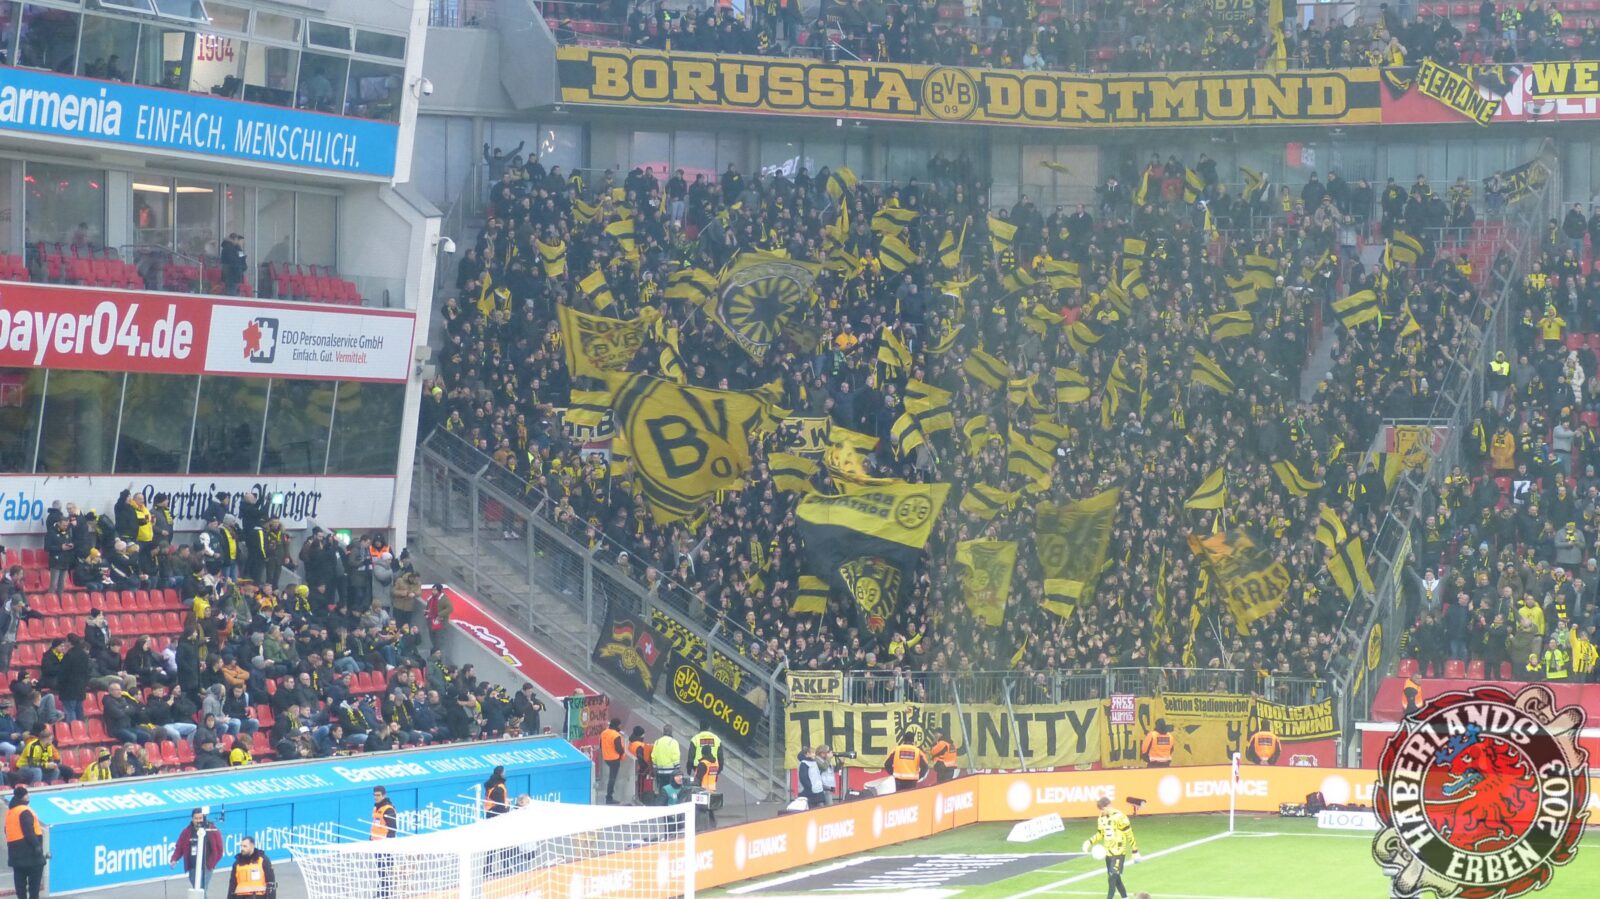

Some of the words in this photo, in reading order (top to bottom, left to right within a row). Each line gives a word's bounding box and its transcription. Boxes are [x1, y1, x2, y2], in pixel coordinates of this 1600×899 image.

[196, 33, 235, 62] 1904
[591, 55, 918, 115] BORUSSIA
[984, 75, 1348, 121] DORTMUND
[930, 73, 972, 106] BVB
[136, 104, 226, 151] EINFACH.
[233, 117, 361, 168] MENSCHLICH.
[281, 330, 299, 345] EDO
[300, 331, 358, 348] Personalservice
[359, 335, 384, 349] GmbH
[292, 348, 318, 361] Einfach.
[320, 350, 333, 362] Gut.
[335, 351, 368, 363] Vermittelt.
[0, 491, 44, 521] abo
[687, 681, 734, 723] BLOCK
[732, 715, 750, 736] 80
[1163, 697, 1193, 712] Sektion
[789, 710, 889, 756] THE
[941, 707, 1098, 759] UNITY
[333, 759, 430, 783] Barmenia
[424, 755, 488, 773] EINFACH.
[481, 747, 568, 768] MENSCHLICH.
[49, 788, 167, 815] Barmenia
[162, 783, 239, 803] EINFACH.
[232, 775, 334, 796] MENSCHLICH.
[943, 792, 974, 814] LEDVANCE
[1035, 784, 1116, 804] LEDVANCE
[1185, 780, 1269, 797] LEDVANCE
[818, 819, 855, 843] LEDVANCE
[884, 805, 919, 829] LEDVANCE
[93, 836, 178, 876] Barmenia
[747, 833, 788, 859] LEDVANCE
